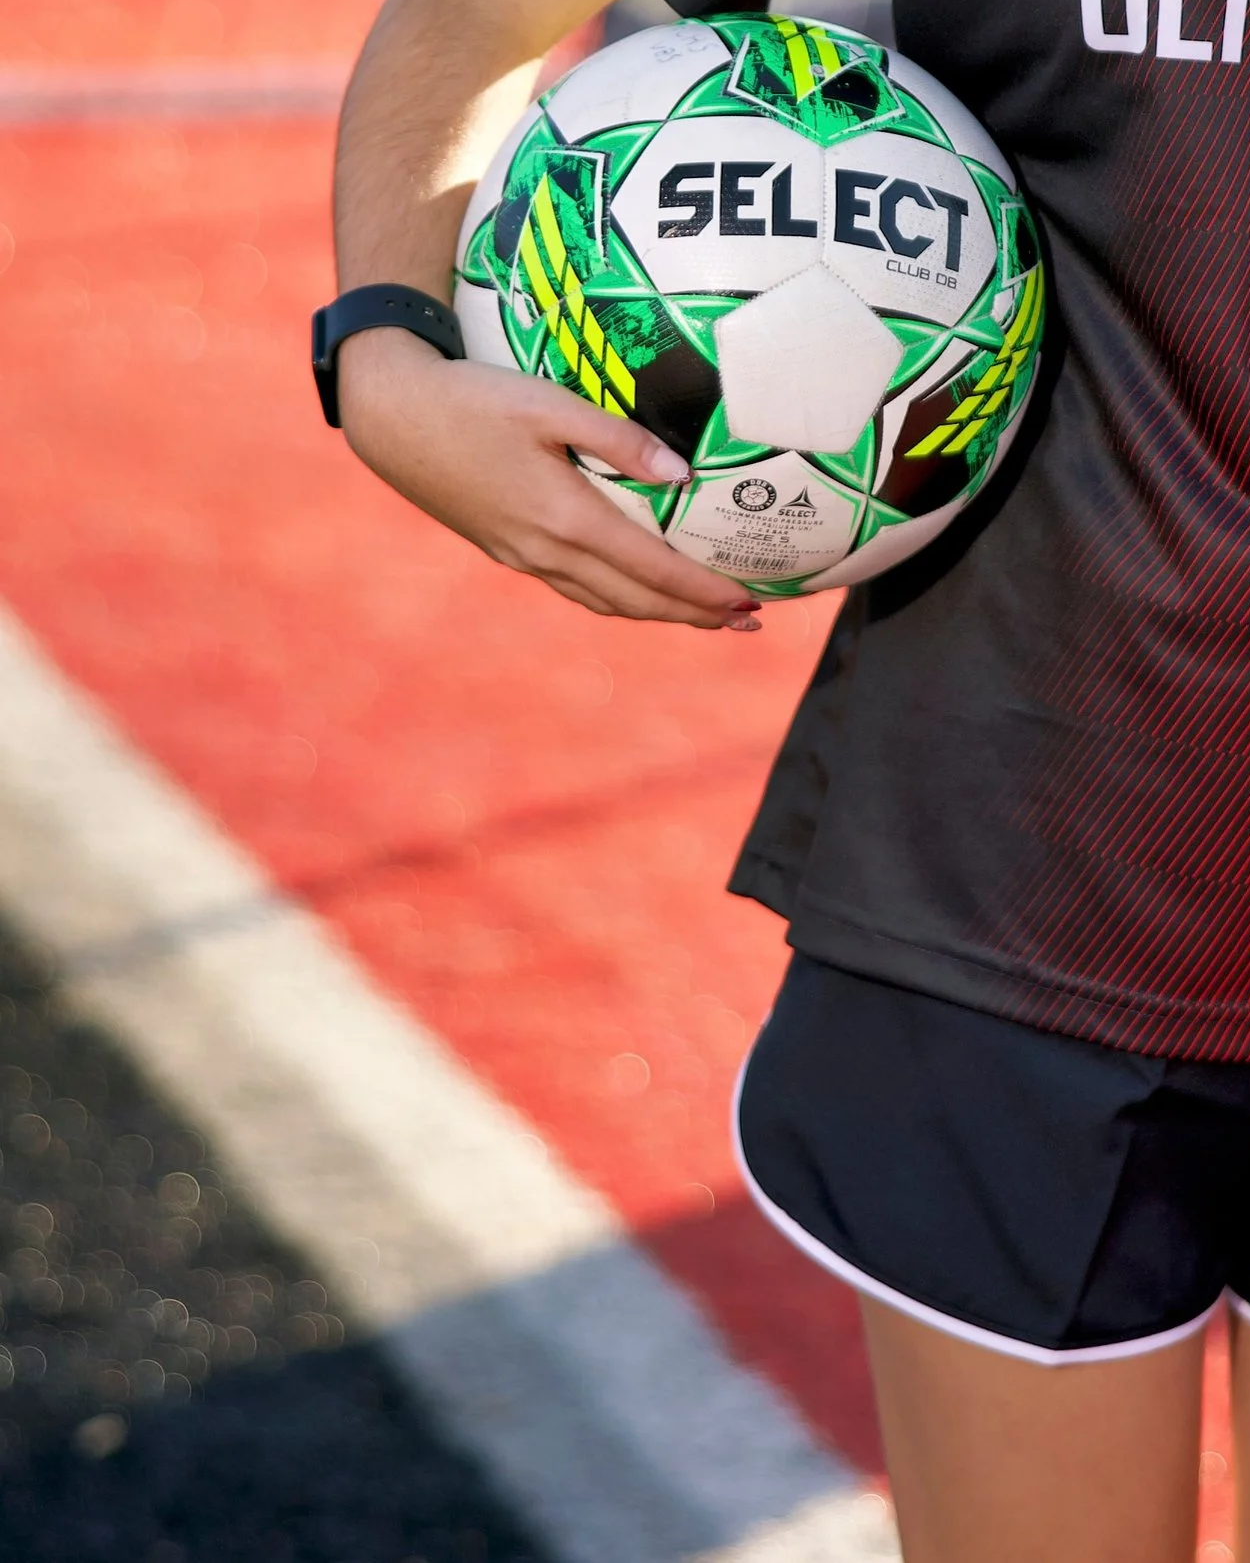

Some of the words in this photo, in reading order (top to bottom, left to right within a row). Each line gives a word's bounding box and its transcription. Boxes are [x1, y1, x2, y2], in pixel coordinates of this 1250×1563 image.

[657, 161, 969, 272] SELECT
[886, 259, 930, 280] CLUB
[935, 273, 957, 289] DB
[715, 506, 778, 523] RECOMMENDED
[780, 518, 824, 526] PRESSURE
[777, 508, 817, 518] SELECT
[735, 529, 775, 542] SIZE
